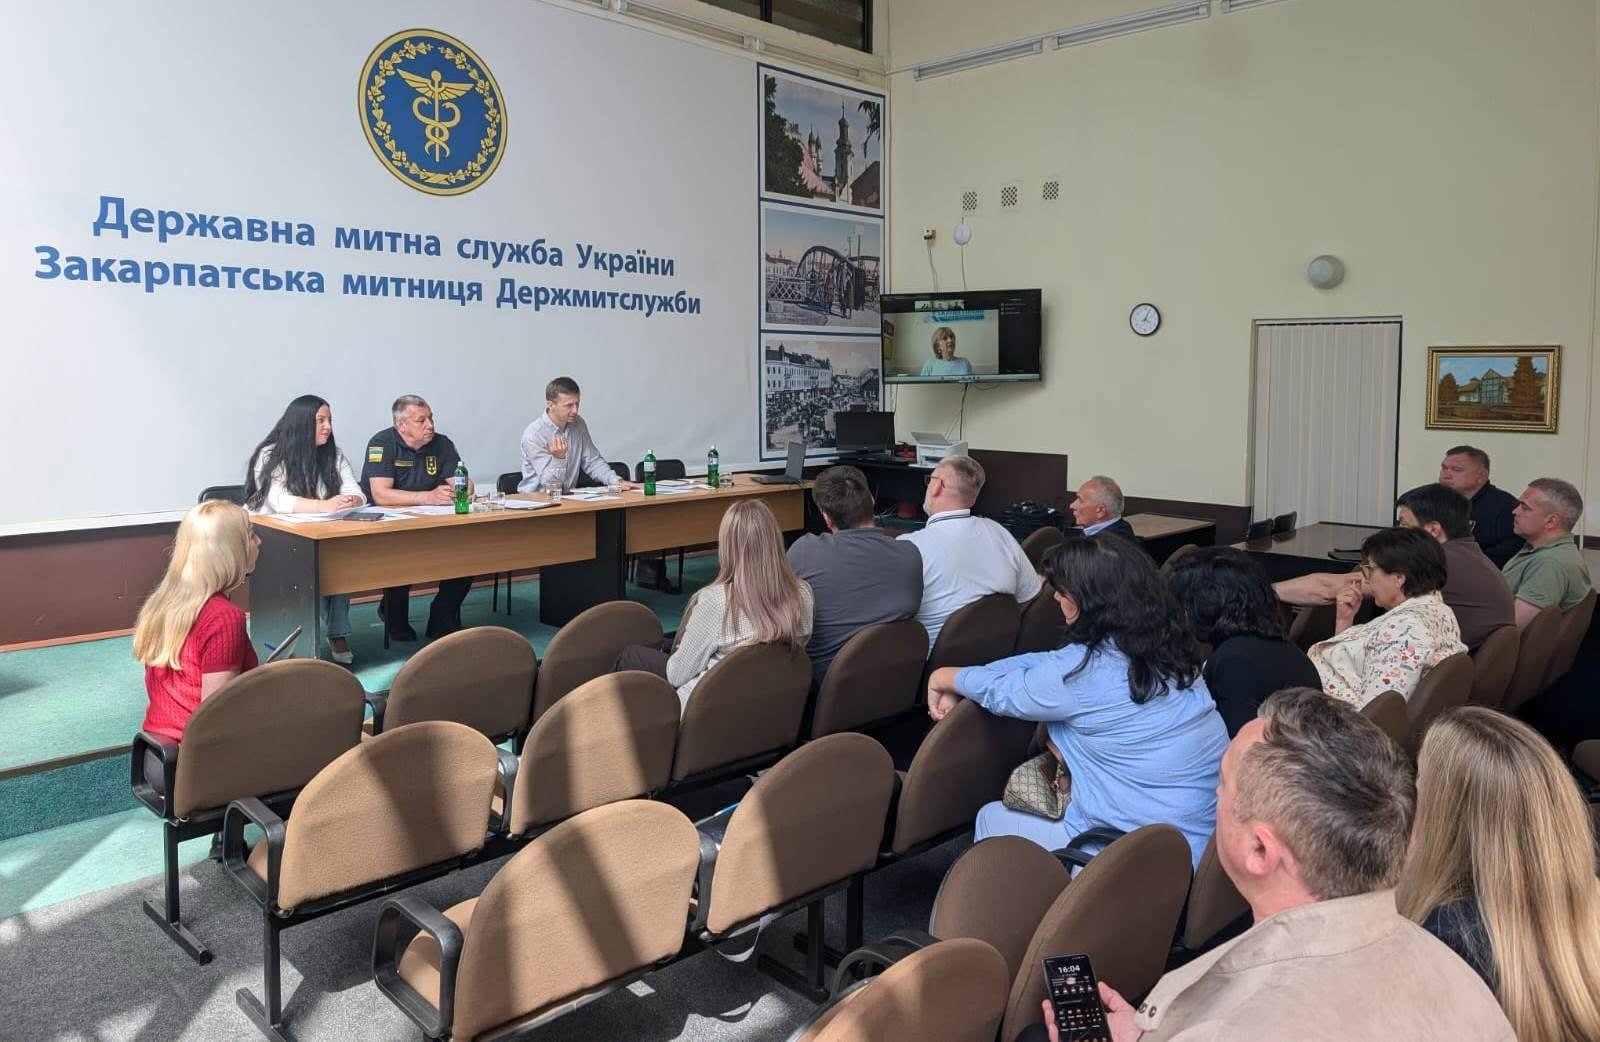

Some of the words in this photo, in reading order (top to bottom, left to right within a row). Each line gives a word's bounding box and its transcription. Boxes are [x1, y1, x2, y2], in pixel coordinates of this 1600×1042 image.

[92, 195, 316, 247] Державна
[334, 226, 442, 257] митна
[456, 238, 564, 269] служба
[575, 242, 676, 278] України
[34, 245, 326, 293] Закарпатська
[342, 274, 483, 307] митниця
[495, 277, 702, 319] Держмитслужби
[1058, 965, 1081, 974] 16:04
